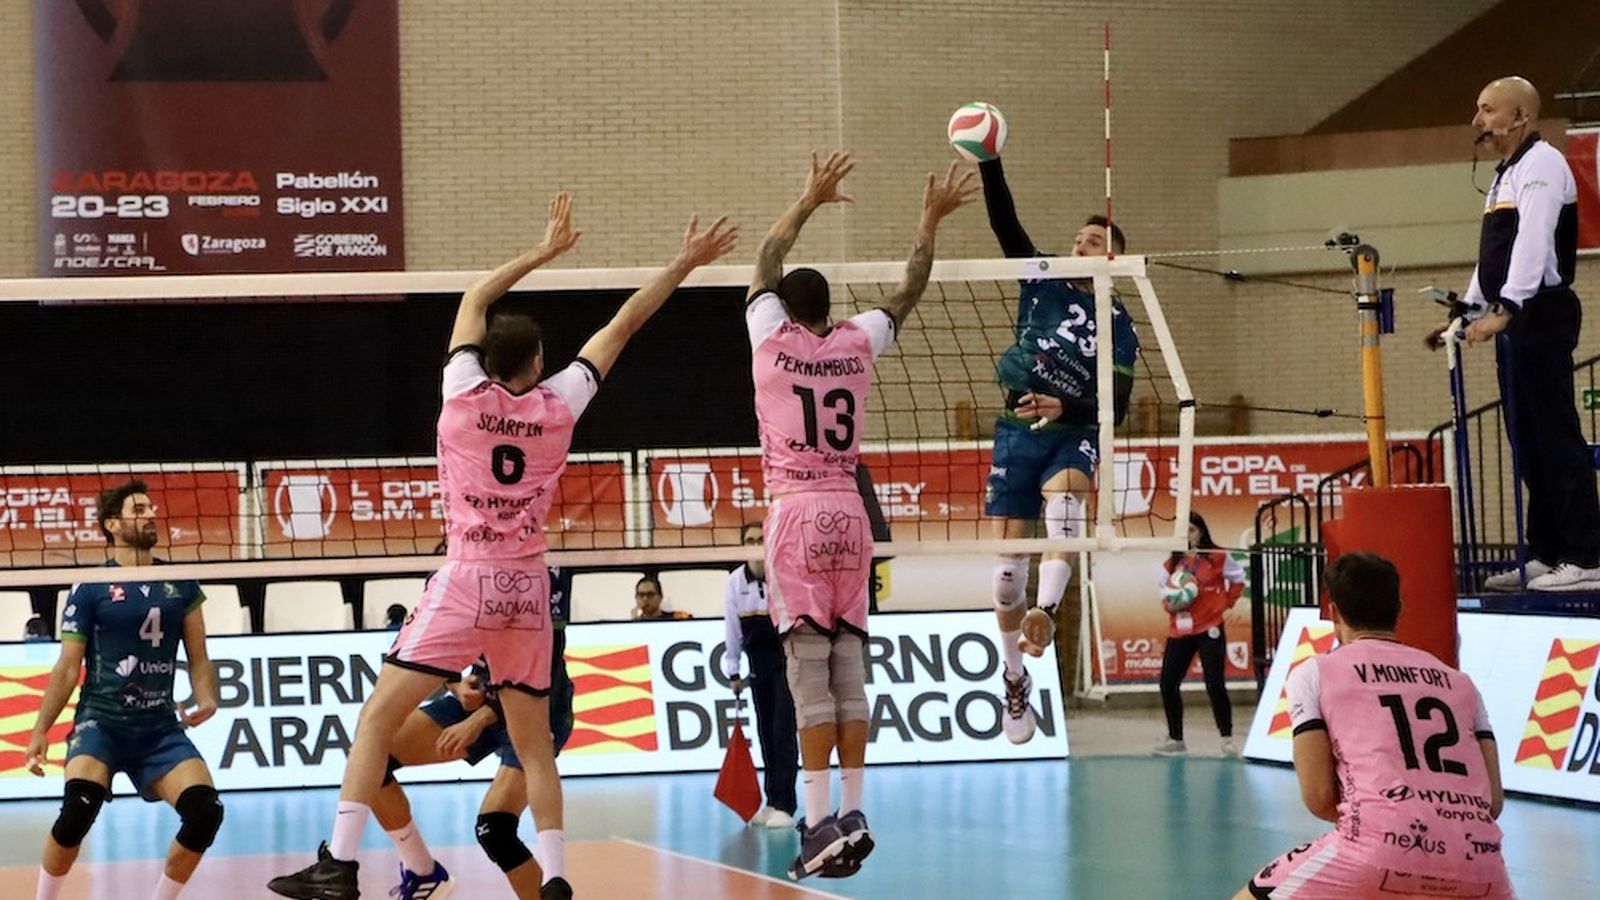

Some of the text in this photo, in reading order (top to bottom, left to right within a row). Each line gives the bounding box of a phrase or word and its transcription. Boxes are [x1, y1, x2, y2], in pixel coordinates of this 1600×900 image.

[52, 171, 257, 192] ZARAGOZA
[276, 172, 379, 190] Pabellón
[51, 195, 169, 218] 20-23
[188, 195, 261, 206] FEBRERO
[276, 197, 337, 218] Siglo
[341, 197, 388, 213] XXI
[201, 236, 267, 254] Zaragoza
[315, 233, 379, 246] GOBIERNO
[315, 246, 333, 257] DE
[774, 351, 864, 377] PERNAMBUCO
[476, 412, 543, 438] SCARPIN
[792, 383, 856, 452] 13
[490, 444, 526, 486] 6
[1200, 455, 1286, 474] COPA
[732, 467, 749, 485] L
[1248, 474, 1291, 495] EL
[352, 480, 441, 498] L COP
[351, 500, 424, 521] S.M.
[484, 599, 541, 617] SADVAL
[139, 606, 164, 648] 4
[1354, 664, 1453, 691] V.MONFORT
[666, 699, 752, 750] DE
[219, 715, 353, 769] ARA
[1378, 694, 1468, 777] 12
